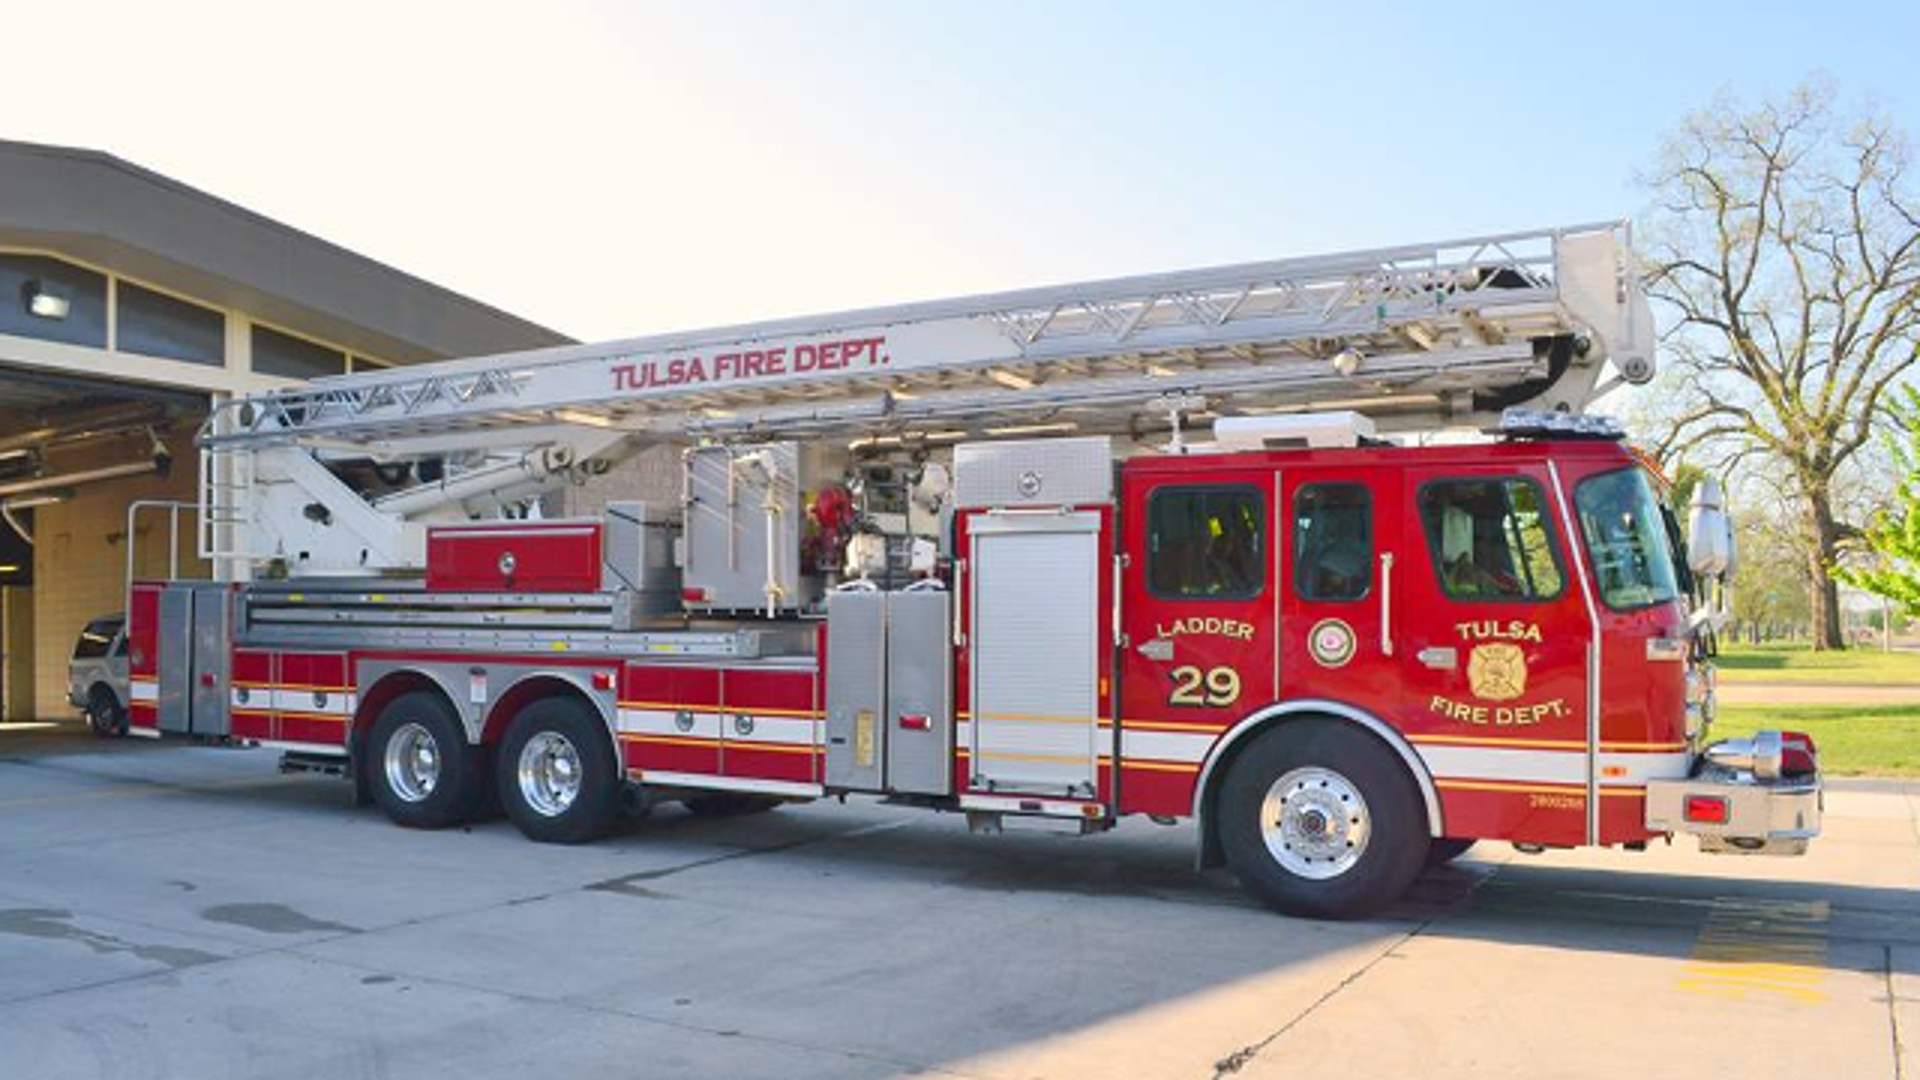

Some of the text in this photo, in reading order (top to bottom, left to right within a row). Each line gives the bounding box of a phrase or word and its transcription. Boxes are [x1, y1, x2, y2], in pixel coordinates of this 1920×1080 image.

[611, 336, 890, 390] TULSA FIRE DEPT.
[1157, 617, 1254, 641] LADDER
[1455, 620, 1542, 642] TULSA
[1168, 665, 1241, 707] 29
[1430, 696, 1571, 724] FIRE DEPT.
